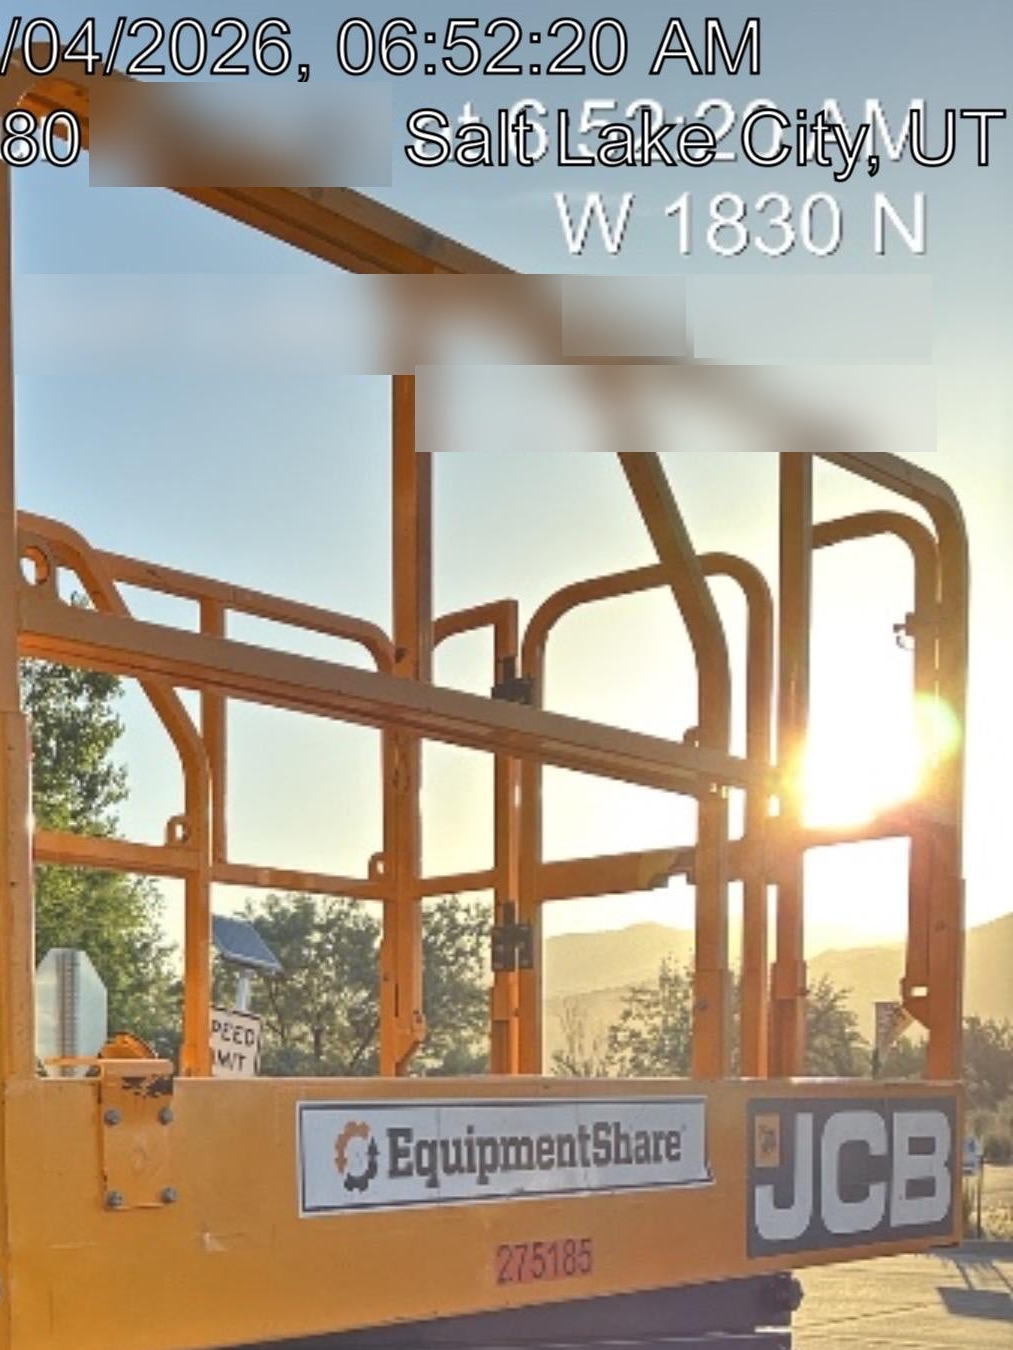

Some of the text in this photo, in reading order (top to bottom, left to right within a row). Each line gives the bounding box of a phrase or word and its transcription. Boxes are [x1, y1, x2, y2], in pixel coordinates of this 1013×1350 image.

[212, 1020, 255, 1047] PEED
[387, 1120, 682, 1188] EquipmentShare
[754, 1110, 951, 1240] JCB
[495, 1237, 593, 1286] 275185
